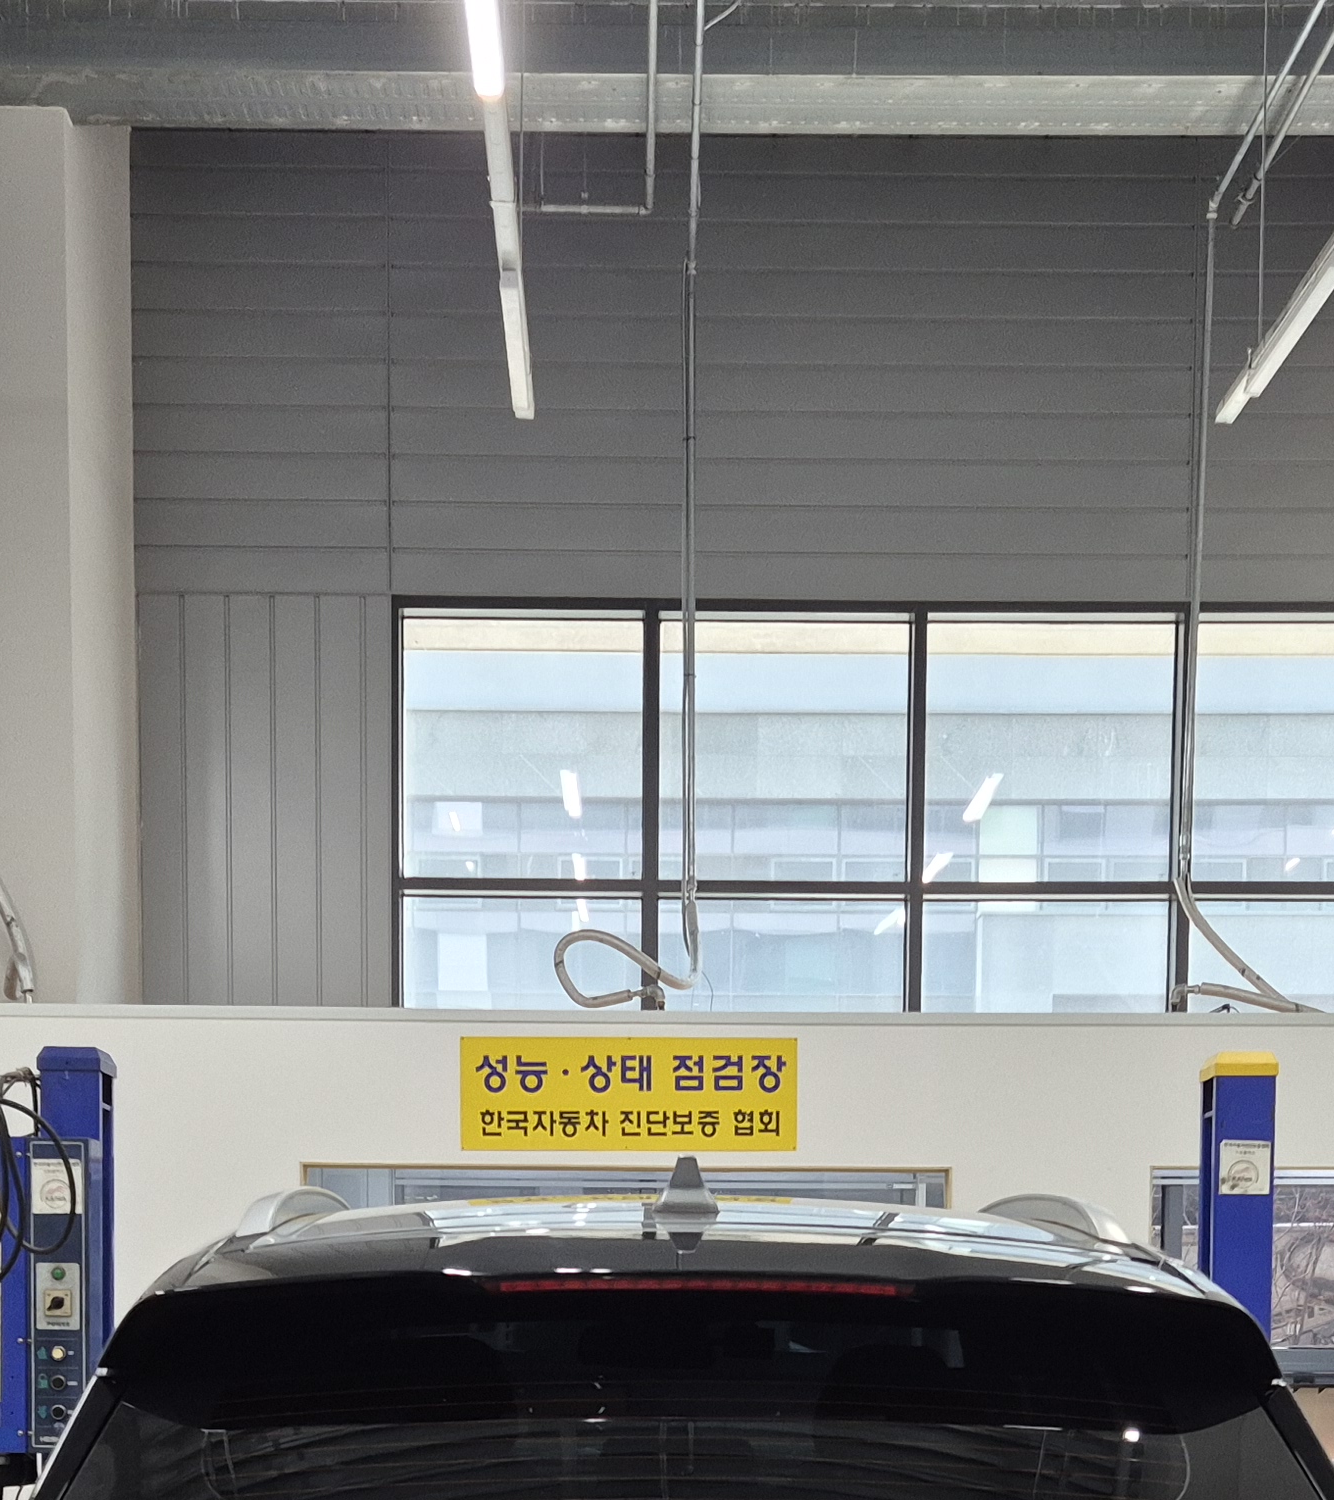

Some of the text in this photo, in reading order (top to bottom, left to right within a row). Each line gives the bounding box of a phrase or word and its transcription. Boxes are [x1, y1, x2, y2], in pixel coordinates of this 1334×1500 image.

[671, 1054, 787, 1093] 점검장
[479, 1108, 782, 1138] 한국자동차 진단보증 협회
